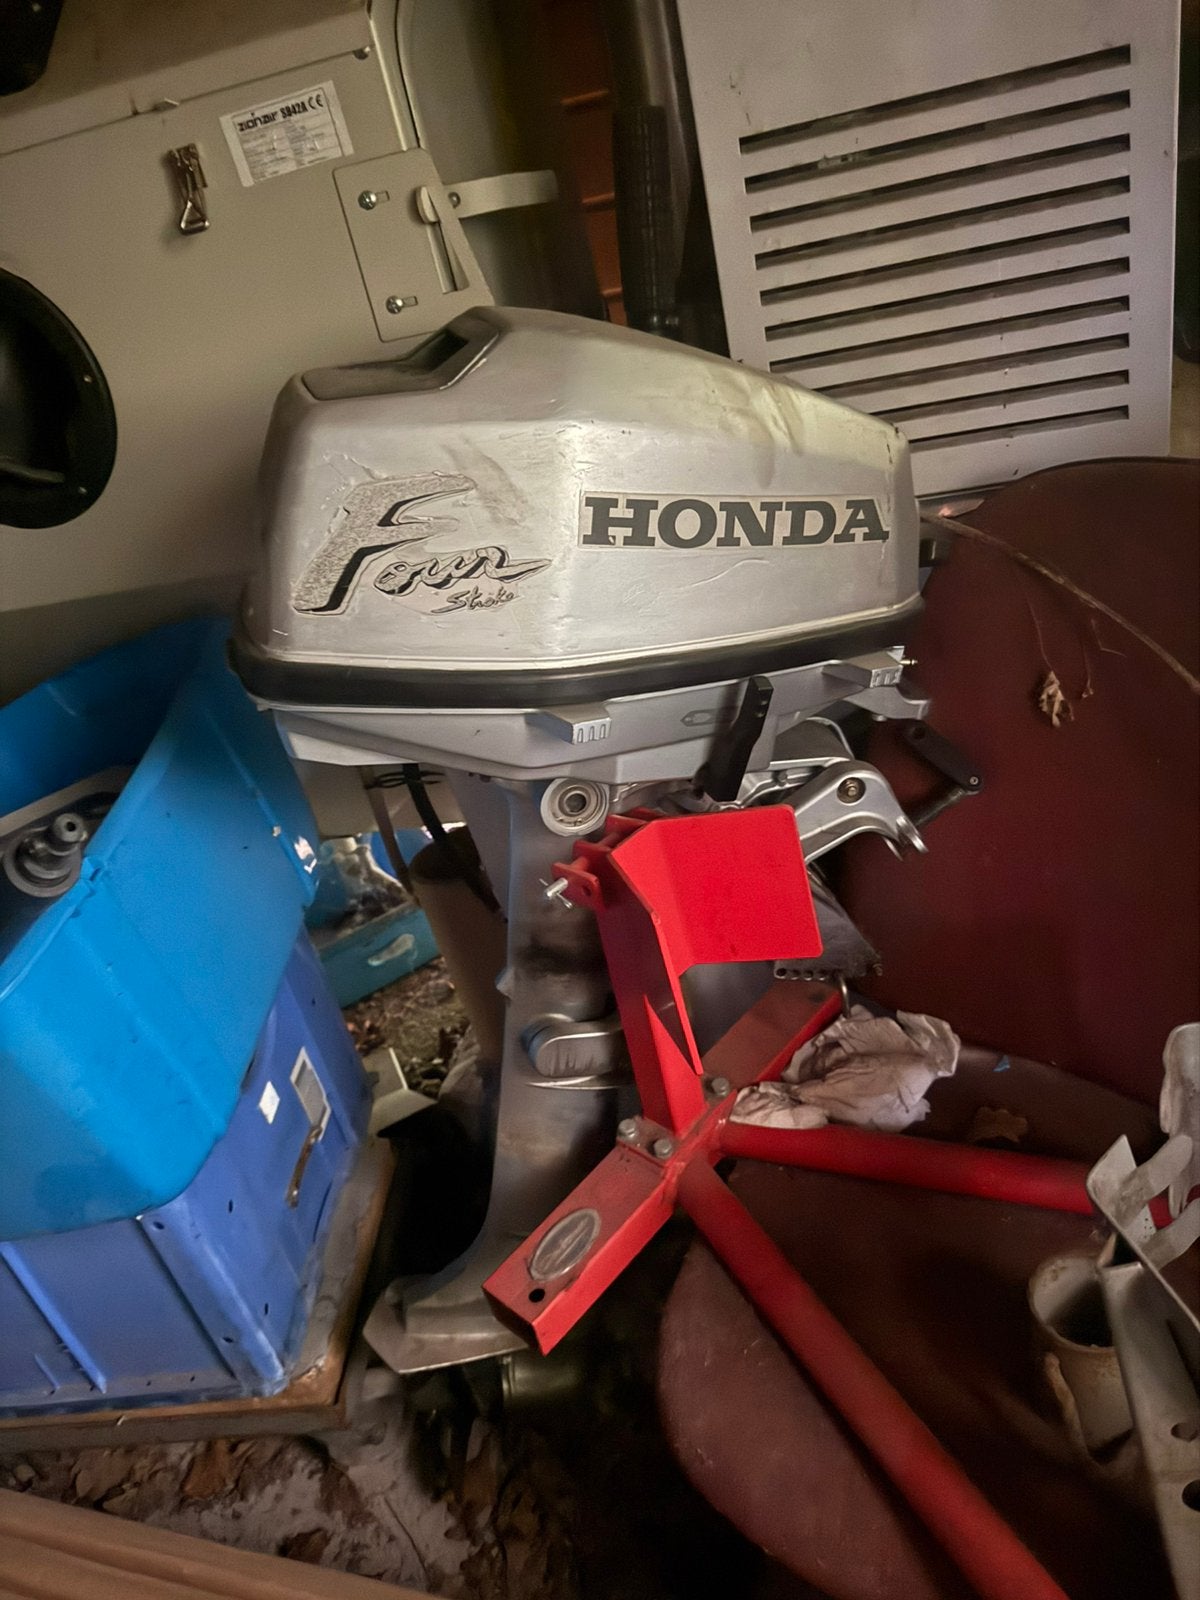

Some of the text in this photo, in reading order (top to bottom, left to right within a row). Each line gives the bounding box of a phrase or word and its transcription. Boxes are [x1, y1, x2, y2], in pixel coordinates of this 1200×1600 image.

[291, 471, 552, 616] Four
[583, 494, 889, 548] HONDA
[433, 585, 519, 615] Stroke
